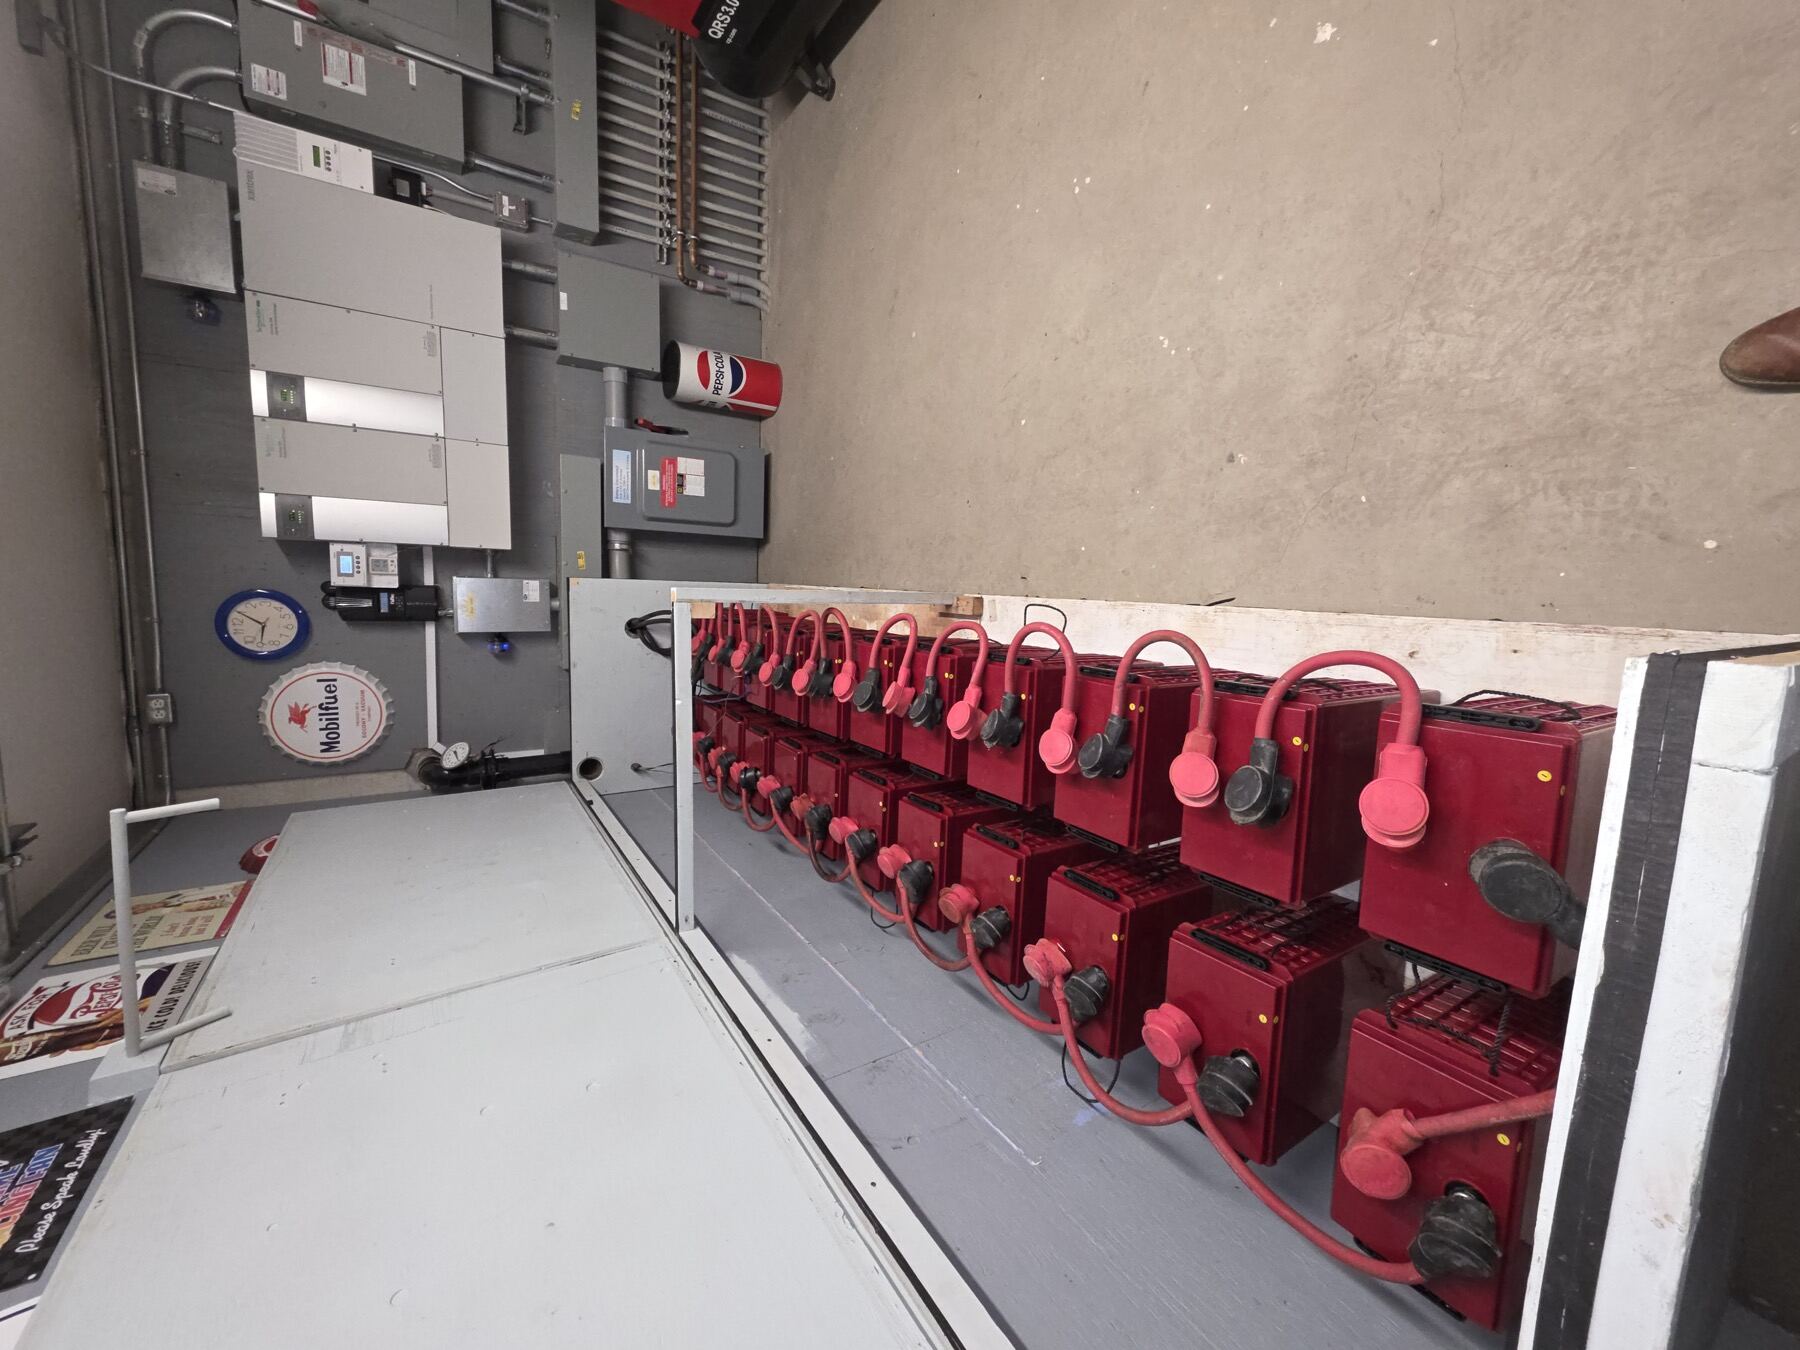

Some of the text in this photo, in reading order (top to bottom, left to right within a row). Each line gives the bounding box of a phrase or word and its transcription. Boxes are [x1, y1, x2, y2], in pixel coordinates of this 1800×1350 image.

[232, 618, 244, 626] 12
[244, 636, 256, 644] 10
[316, 678, 340, 753] Mobilfuel
[168, 960, 202, 995] DELICIOUS!
[8, 1012, 31, 1030] ASK
[23, 994, 48, 1010] FOR
[154, 996, 182, 1018] COLD!
[144, 1019, 168, 1032] ICE
[15, 1143, 64, 1185] FAN
[15, 1128, 107, 1252] Please Speak Loudly!
